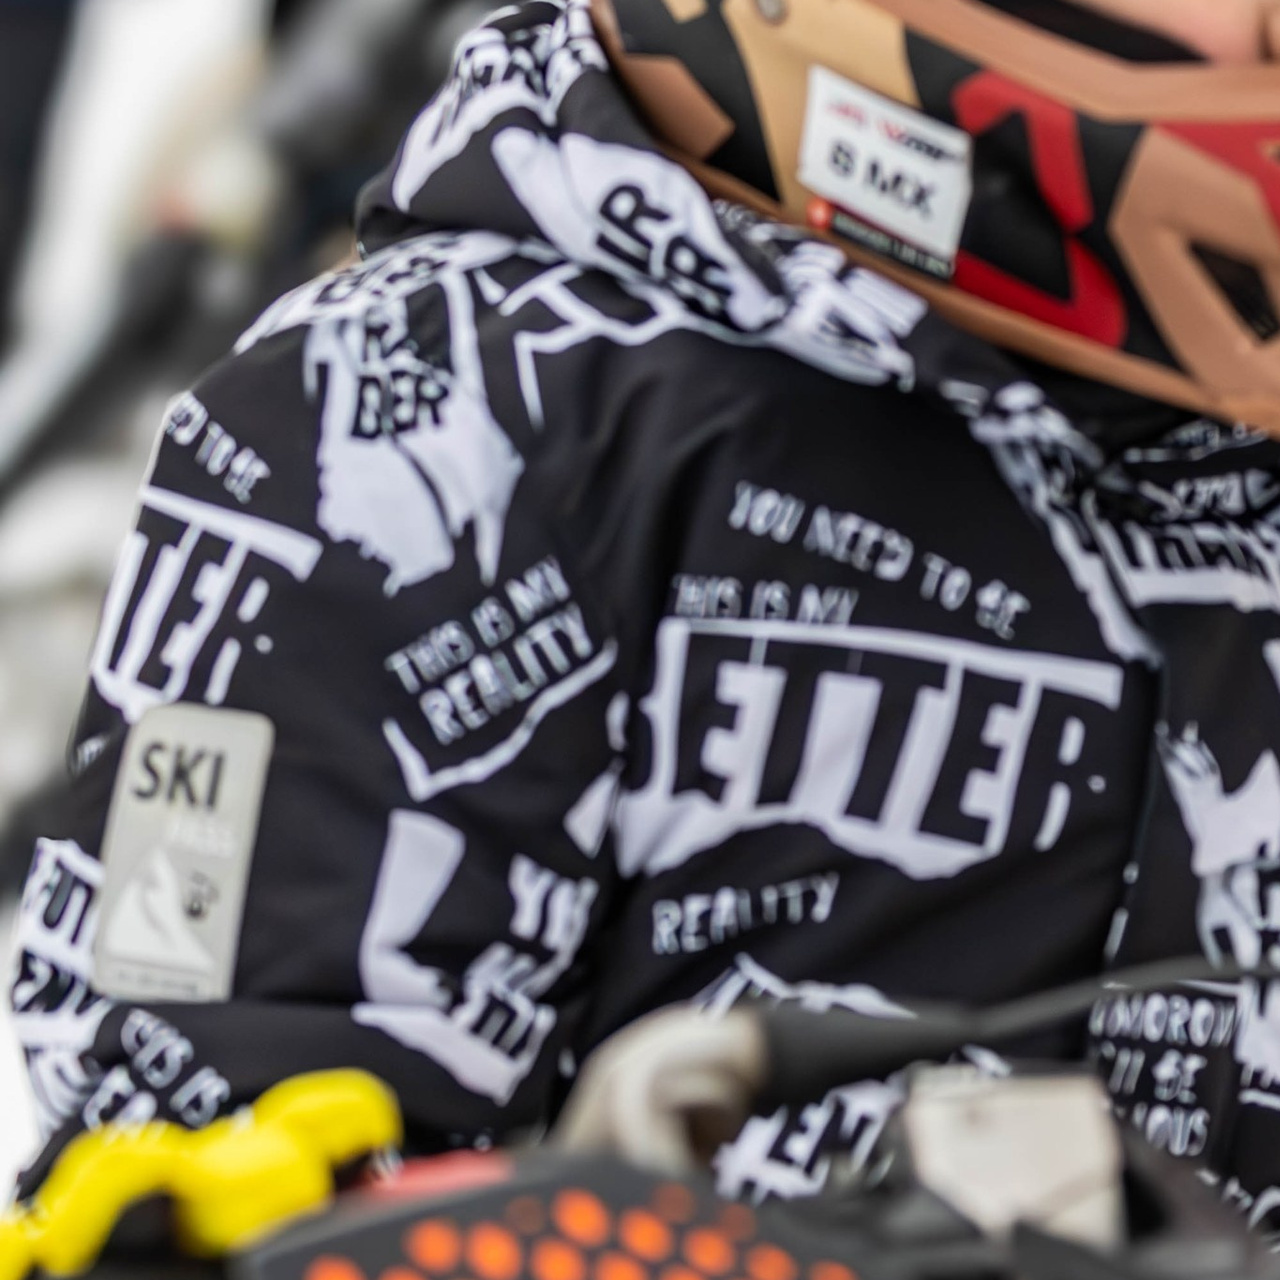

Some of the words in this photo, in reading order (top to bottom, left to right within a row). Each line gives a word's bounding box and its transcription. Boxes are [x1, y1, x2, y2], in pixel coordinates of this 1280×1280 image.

[729, 480, 804, 543] YOU
[919, 551, 973, 612] TO
[418, 602, 594, 746] REALITY
[132, 741, 226, 812] SKI
[652, 871, 840, 955] REALITY
